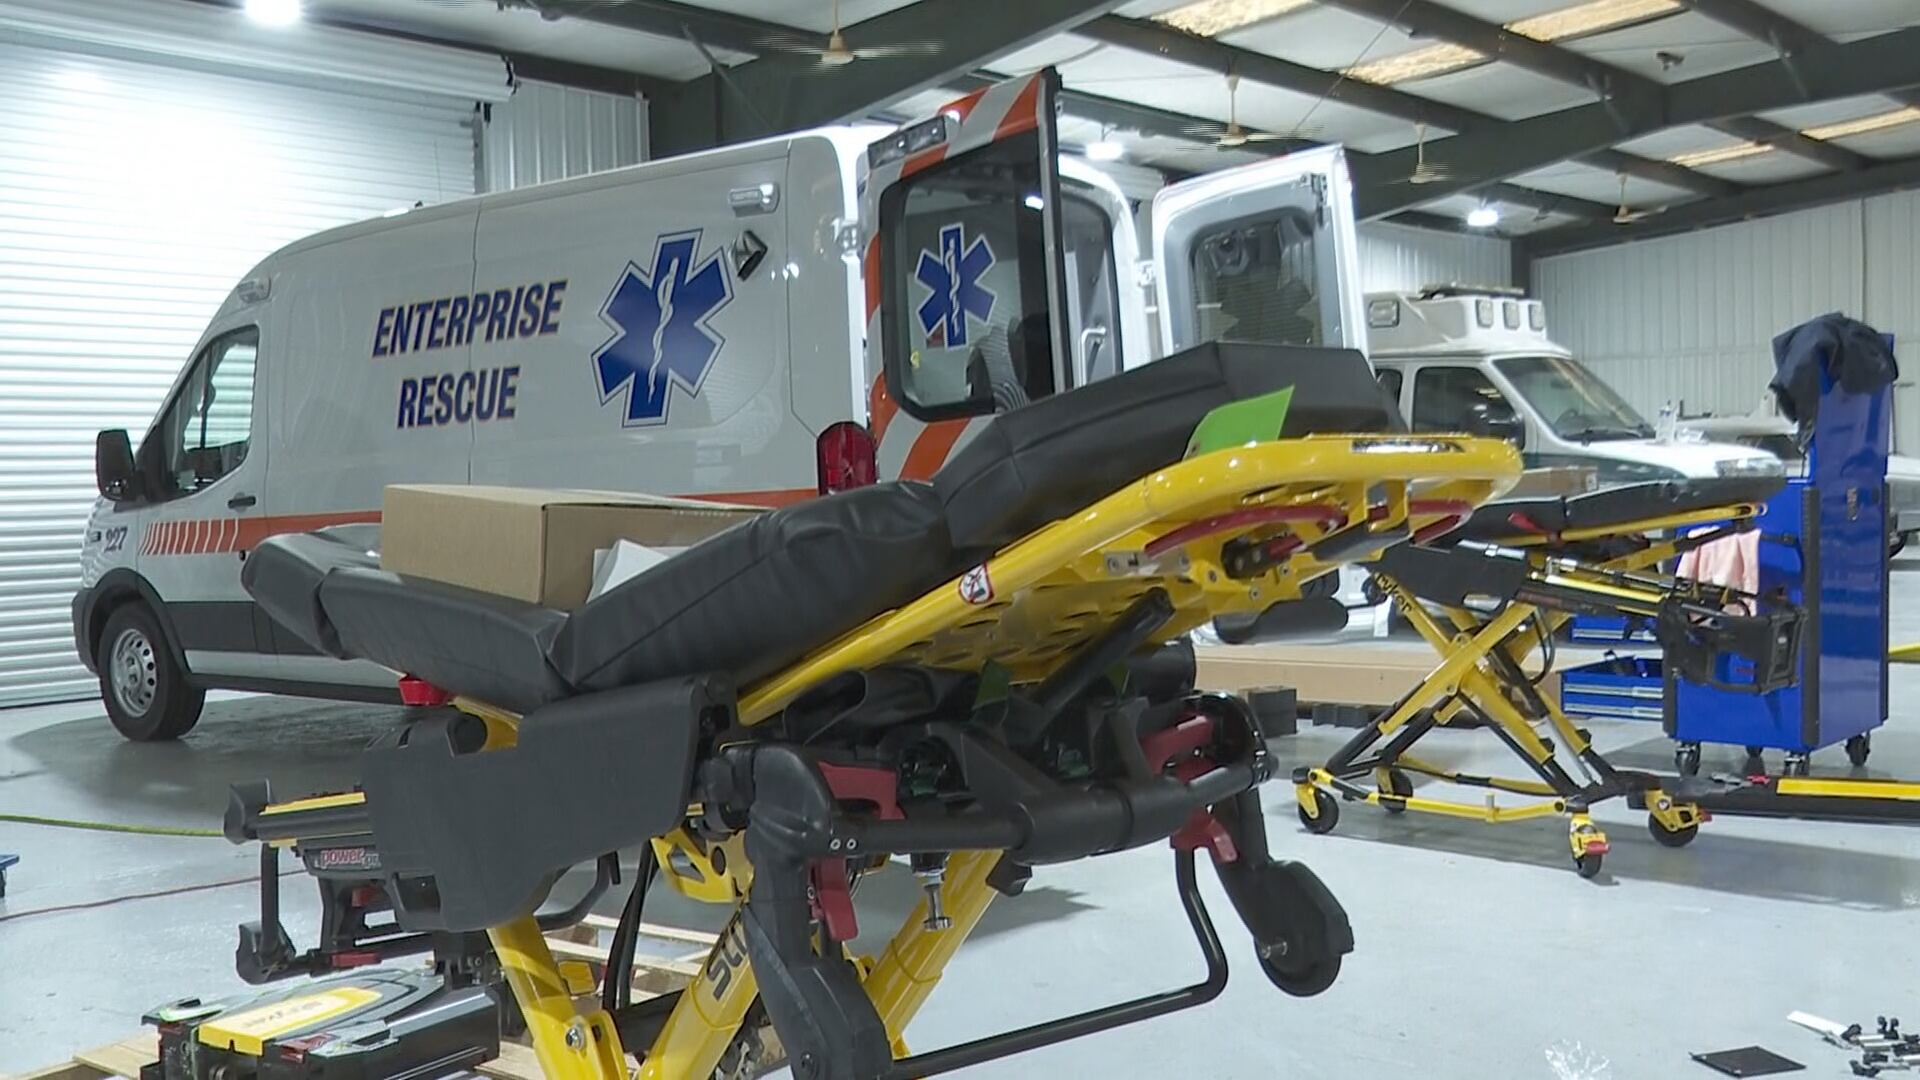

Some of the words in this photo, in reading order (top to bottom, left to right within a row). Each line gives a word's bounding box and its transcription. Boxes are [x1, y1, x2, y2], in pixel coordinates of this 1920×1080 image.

[371, 278, 569, 359] ENTERPRISE
[397, 364, 521, 430] RESCUE
[103, 526, 128, 553] 227
[320, 847, 366, 870] power
